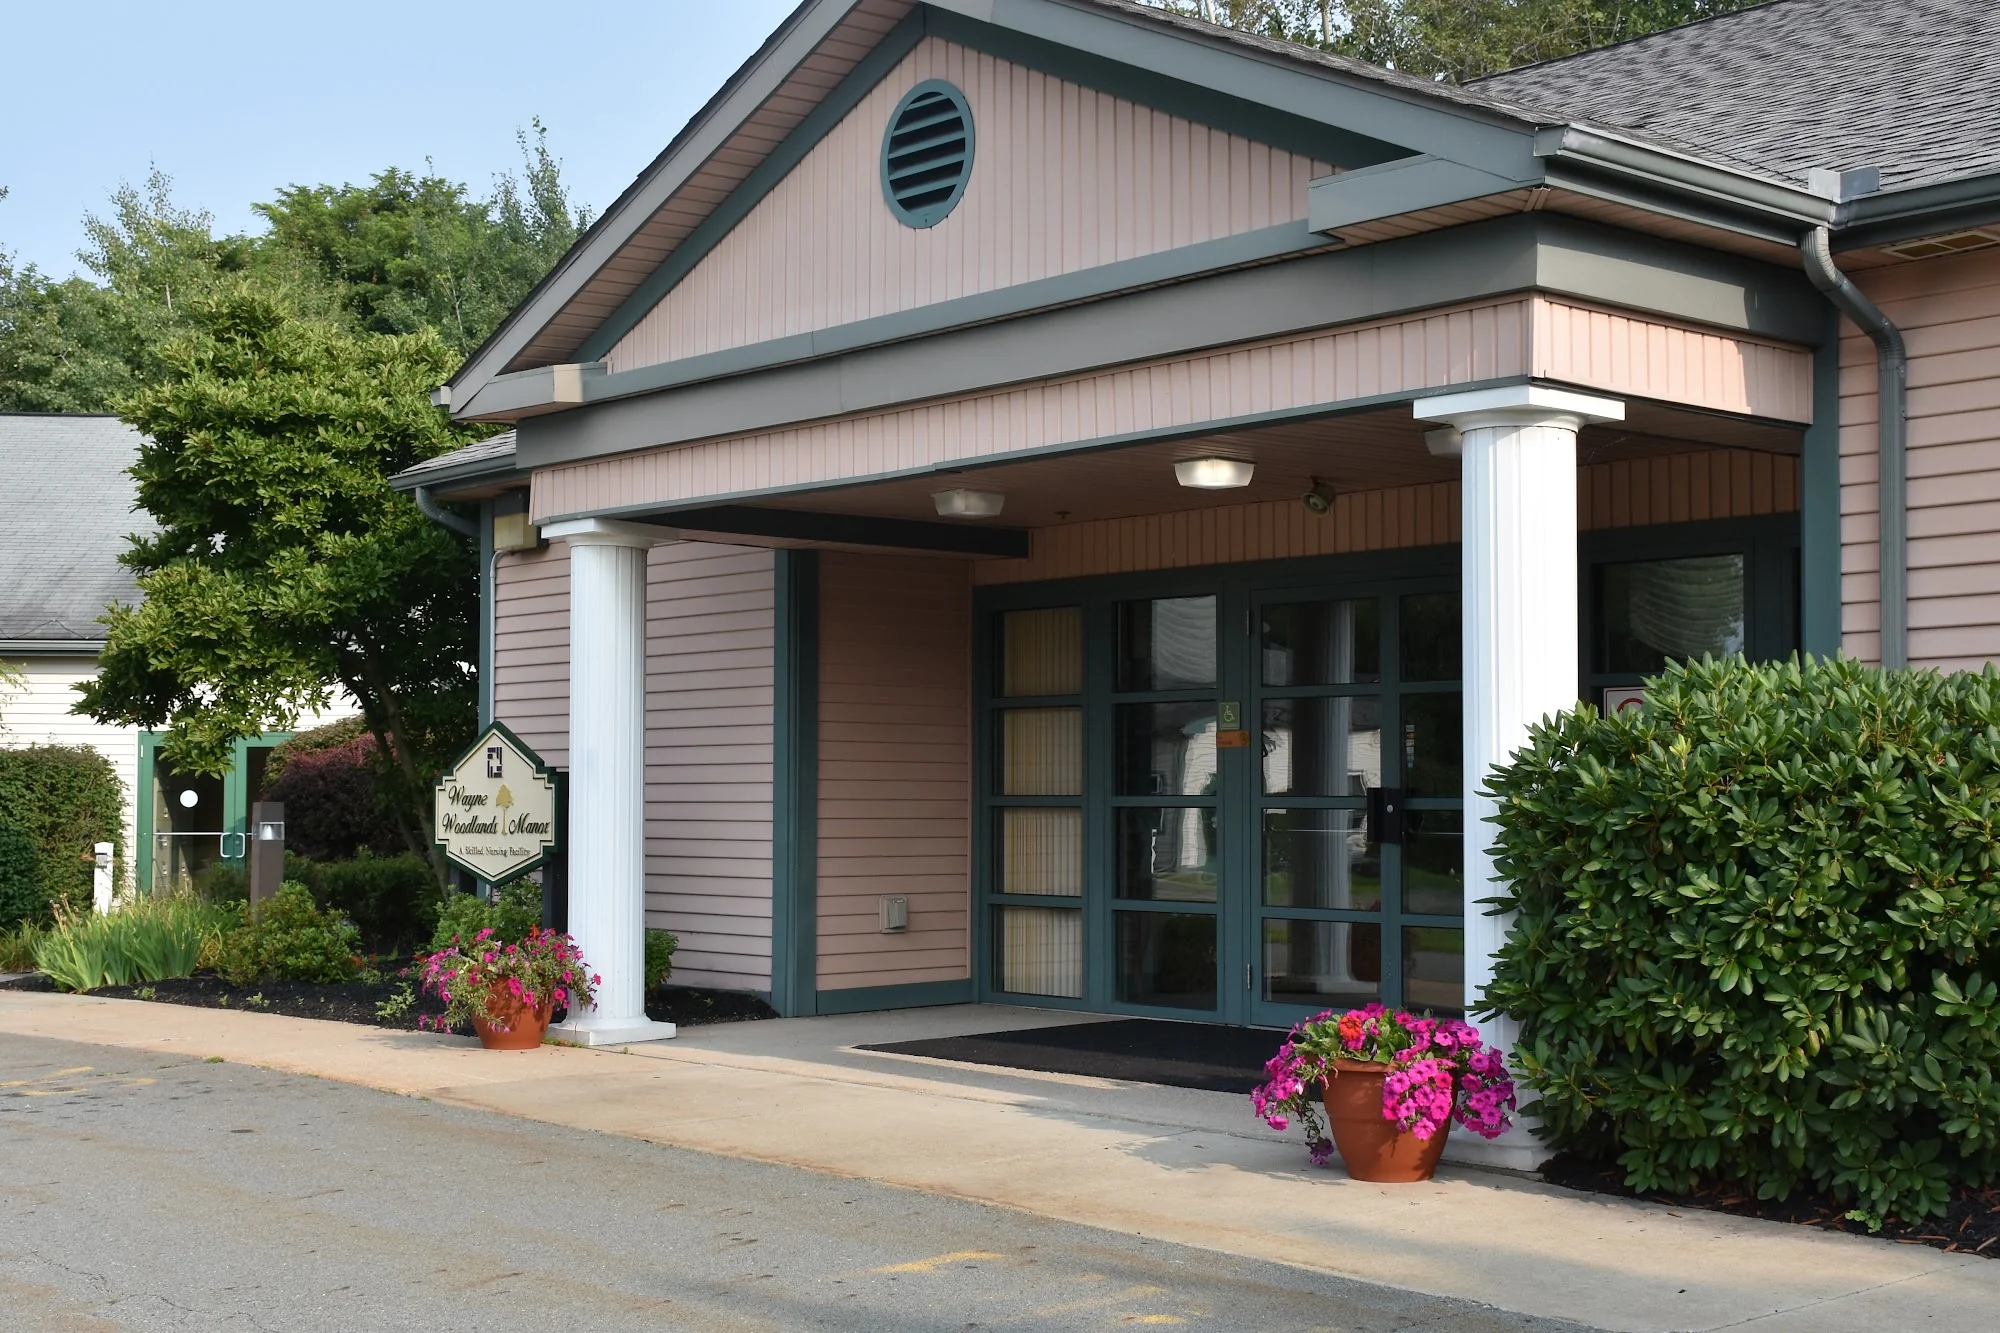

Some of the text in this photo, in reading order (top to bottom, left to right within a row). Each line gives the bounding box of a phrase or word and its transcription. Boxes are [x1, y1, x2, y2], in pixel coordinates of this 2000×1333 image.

[448, 785, 488, 812] Wayne
[442, 812, 551, 835] Woodlands Manor
[458, 846, 531, 857] A Skilled Nursing Facility
